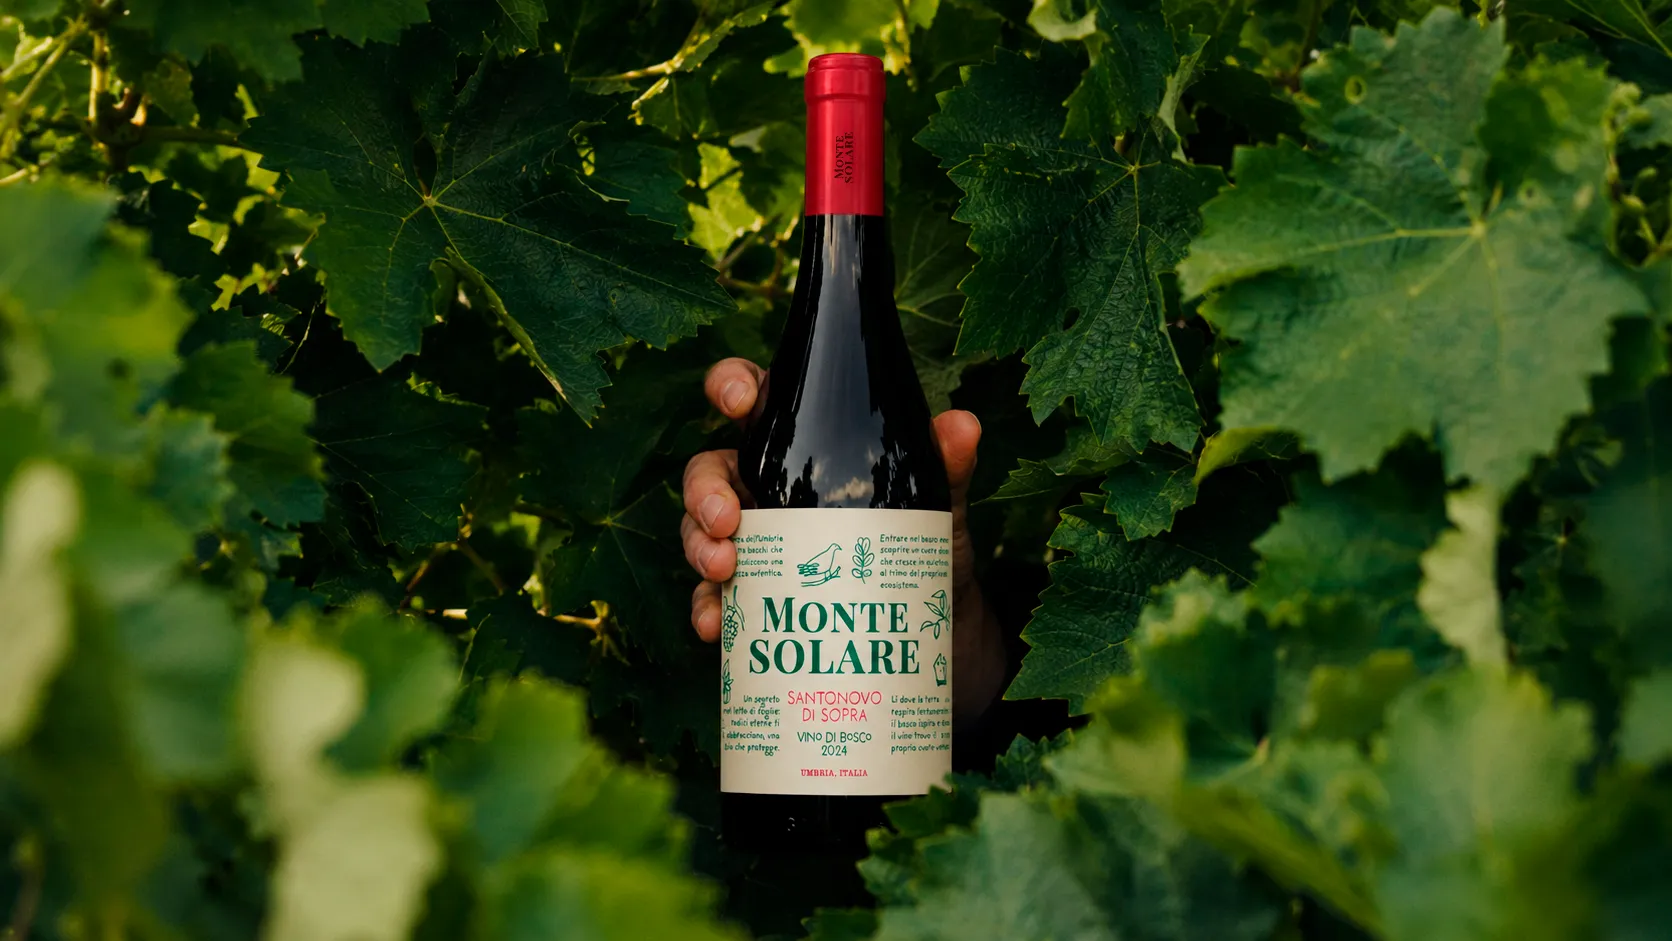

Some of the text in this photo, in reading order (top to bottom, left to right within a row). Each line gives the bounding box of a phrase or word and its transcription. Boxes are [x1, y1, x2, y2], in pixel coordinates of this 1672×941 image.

[834, 135, 844, 179] MONTE
[844, 131, 854, 184] SOLARE
[880, 533, 908, 543] Entrare
[910, 534, 920, 543] nel
[770, 545, 783, 554] che
[880, 545, 909, 556] scoprire
[880, 557, 893, 566] che
[918, 557, 925, 566] in
[880, 569, 887, 577] al
[909, 569, 920, 577] del
[880, 581, 919, 590] ecosistema.
[761, 596, 909, 634] MONTE
[749, 638, 920, 675] SOLARE
[743, 695, 780, 708] Un segreto
[787, 690, 882, 706] SANTONOVO
[900, 695, 916, 703] dove
[802, 707, 867, 723] DI SOPRA
[797, 731, 872, 743] VINO DI BOSCO
[891, 731, 896, 740] il
[821, 744, 848, 756] 2024
[891, 744, 917, 755] proprio
[801, 768, 868, 778] UMBRIA, ITALIA
